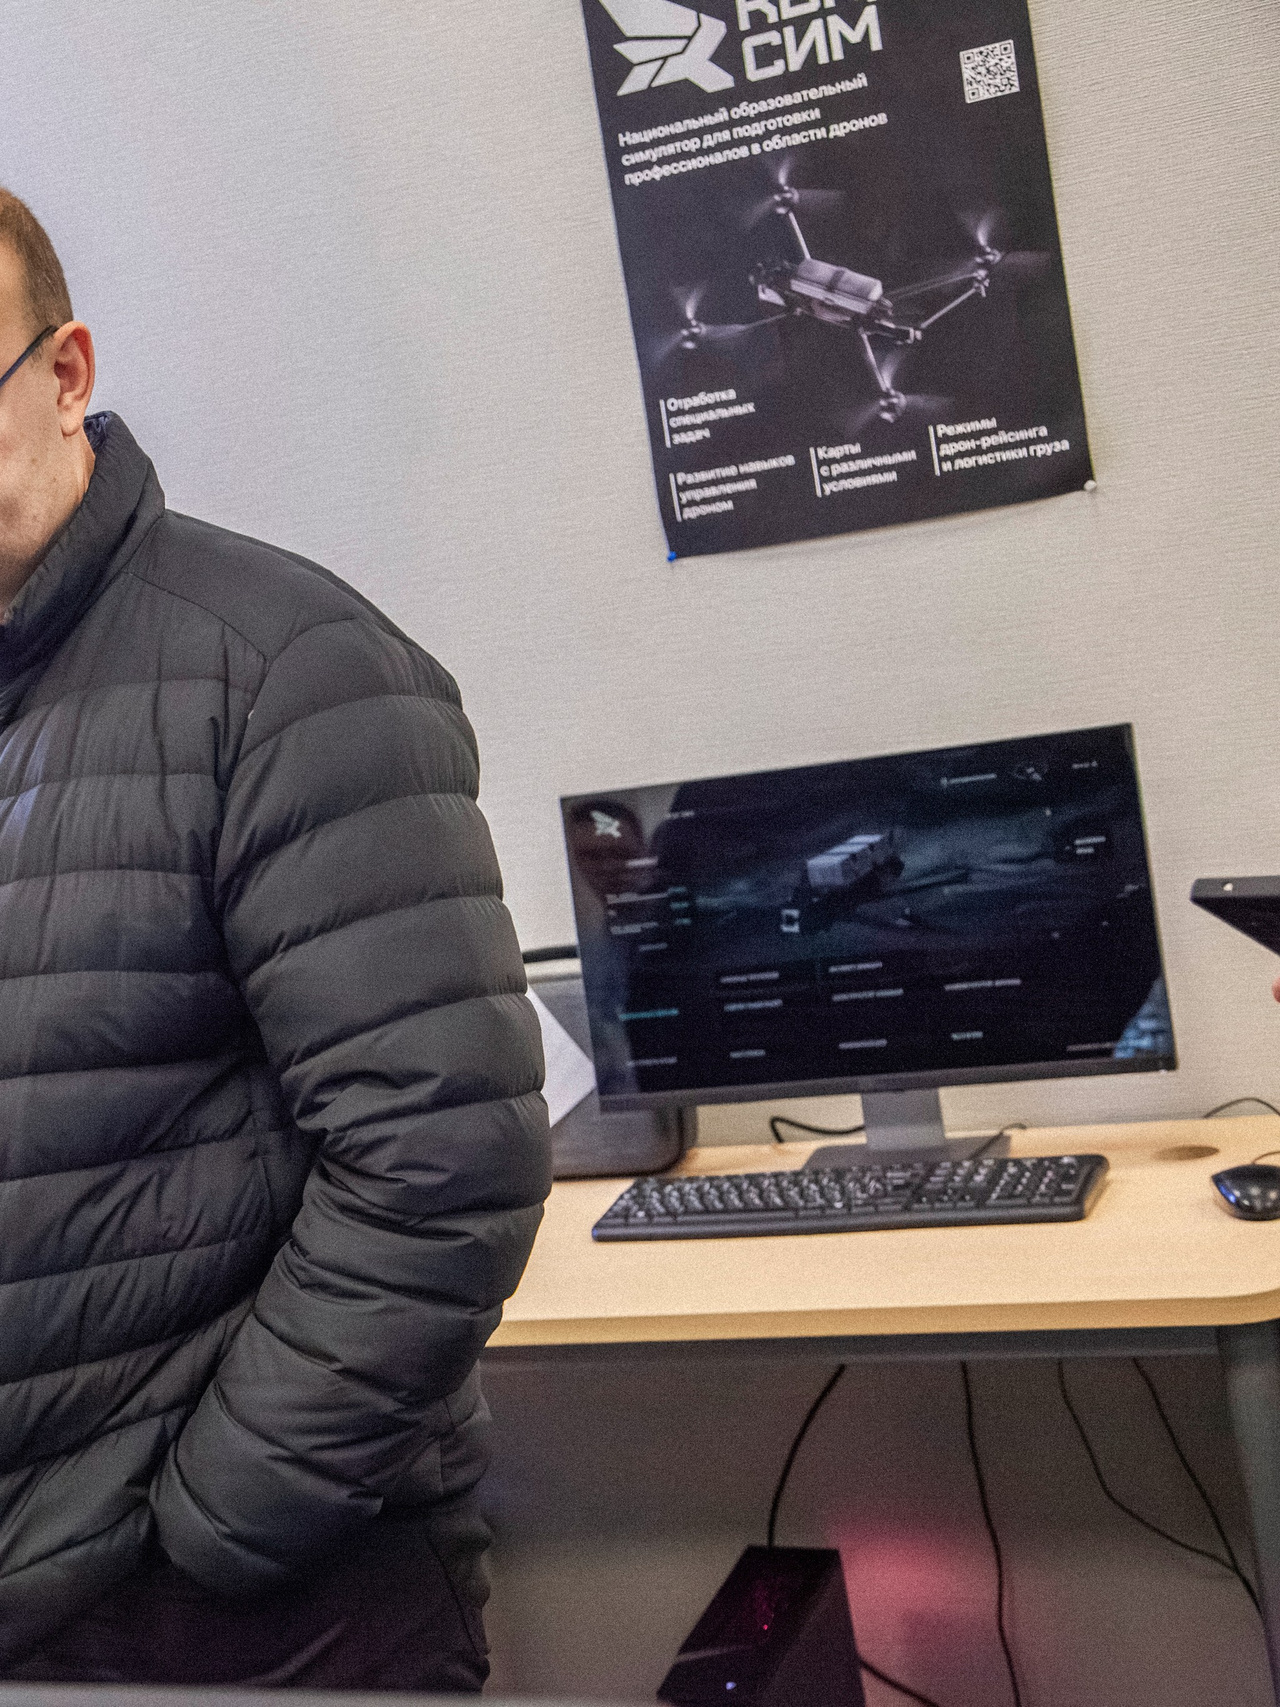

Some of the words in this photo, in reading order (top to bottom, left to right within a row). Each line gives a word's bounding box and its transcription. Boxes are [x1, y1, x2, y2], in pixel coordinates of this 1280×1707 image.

[742, 4, 883, 82] СИМ
[618, 106, 729, 147] Национальный
[730, 72, 868, 117] образовательный
[621, 137, 701, 166] симулятор
[702, 129, 732, 149] для
[732, 107, 821, 139] подготовки
[624, 145, 750, 187] профессионалов
[750, 142, 762, 155] в
[762, 126, 827, 151] области
[829, 112, 889, 139] дронов
[666, 388, 737, 412] Отработка
[669, 402, 756, 428] специальных
[935, 417, 997, 438] Режимы
[671, 428, 711, 445] задач
[939, 425, 1048, 457] дрон-рейсинга
[816, 442, 862, 460] Карты
[820, 465, 830, 477] с
[830, 449, 917, 477] различными
[941, 460, 953, 472] и
[954, 446, 1028, 471] логистики
[1028, 439, 1070, 458] груза
[676, 465, 738, 486] Развитие
[738, 454, 796, 475] навыков
[822, 470, 898, 496] условиями
[679, 478, 758, 505] управления
[682, 499, 734, 520] дроном
